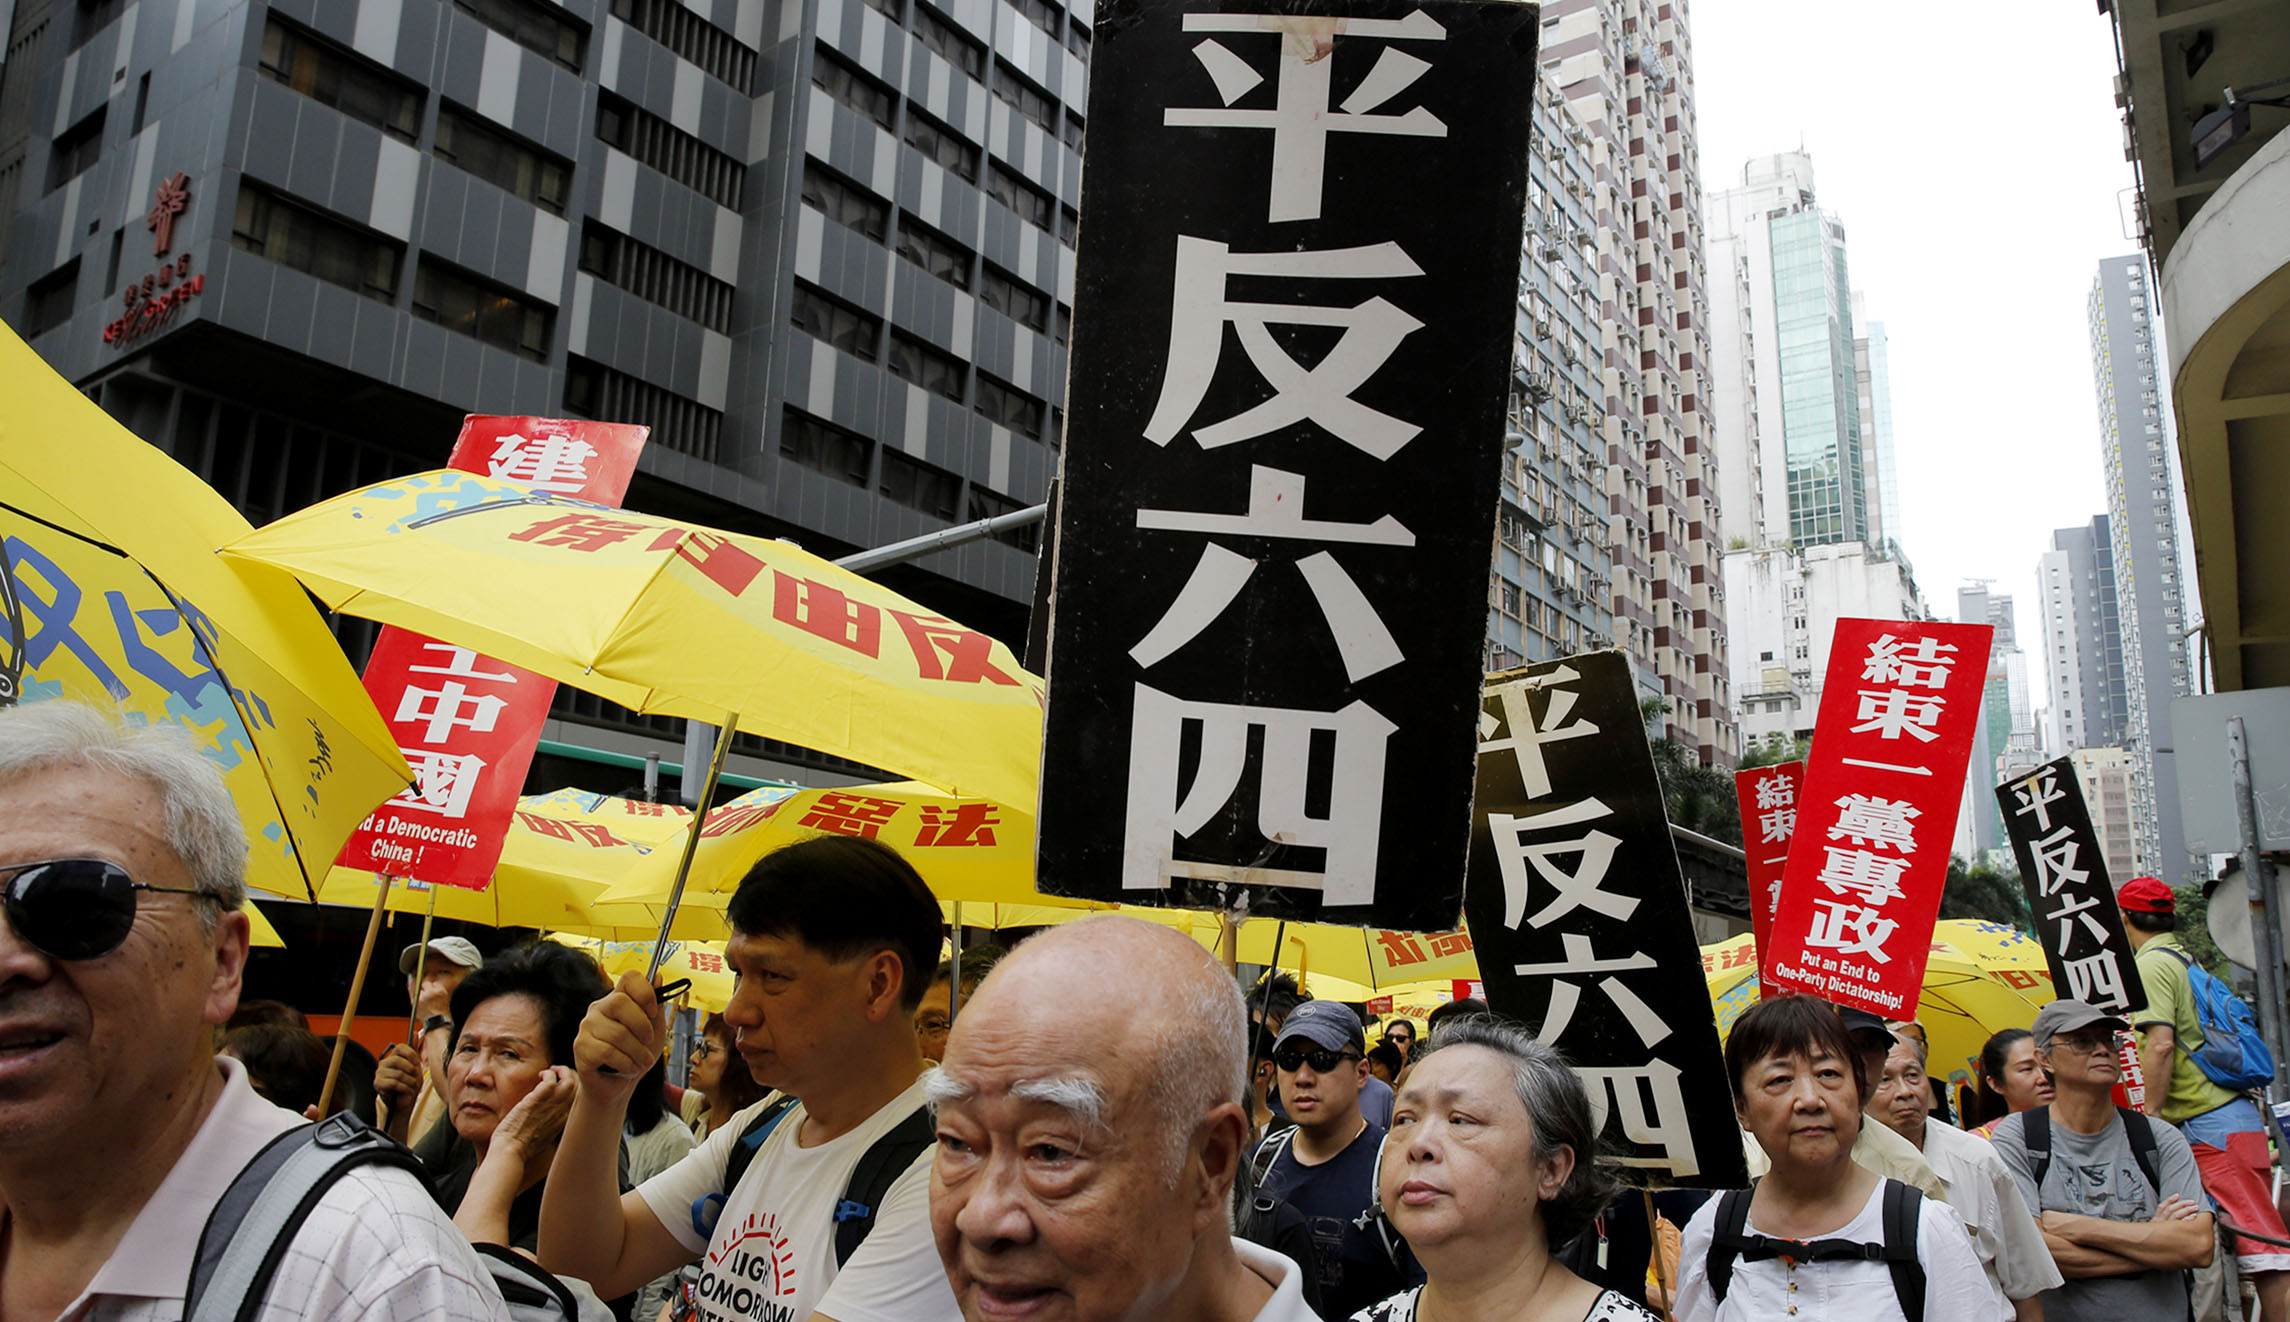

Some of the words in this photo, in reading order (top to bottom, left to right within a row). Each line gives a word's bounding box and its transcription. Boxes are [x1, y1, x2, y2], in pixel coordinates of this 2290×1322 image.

[487, 434, 598, 493] 建
[1122, 9, 1448, 906] 平反六四
[1804, 633, 1960, 965] 結束一黨專政
[371, 838, 413, 863] China
[375, 819, 385, 832] a
[386, 815, 478, 849] Democratic
[2010, 765, 2131, 1011] 平反六四
[1478, 664, 1700, 1177] 平反六四
[1776, 962, 1827, 990] One-Party
[1828, 975, 1904, 1009] Dictatorship!
[1801, 950, 1820, 967] Put
[1822, 958, 1838, 972] an
[1839, 960, 1865, 979] End
[1867, 968, 1880, 984] to
